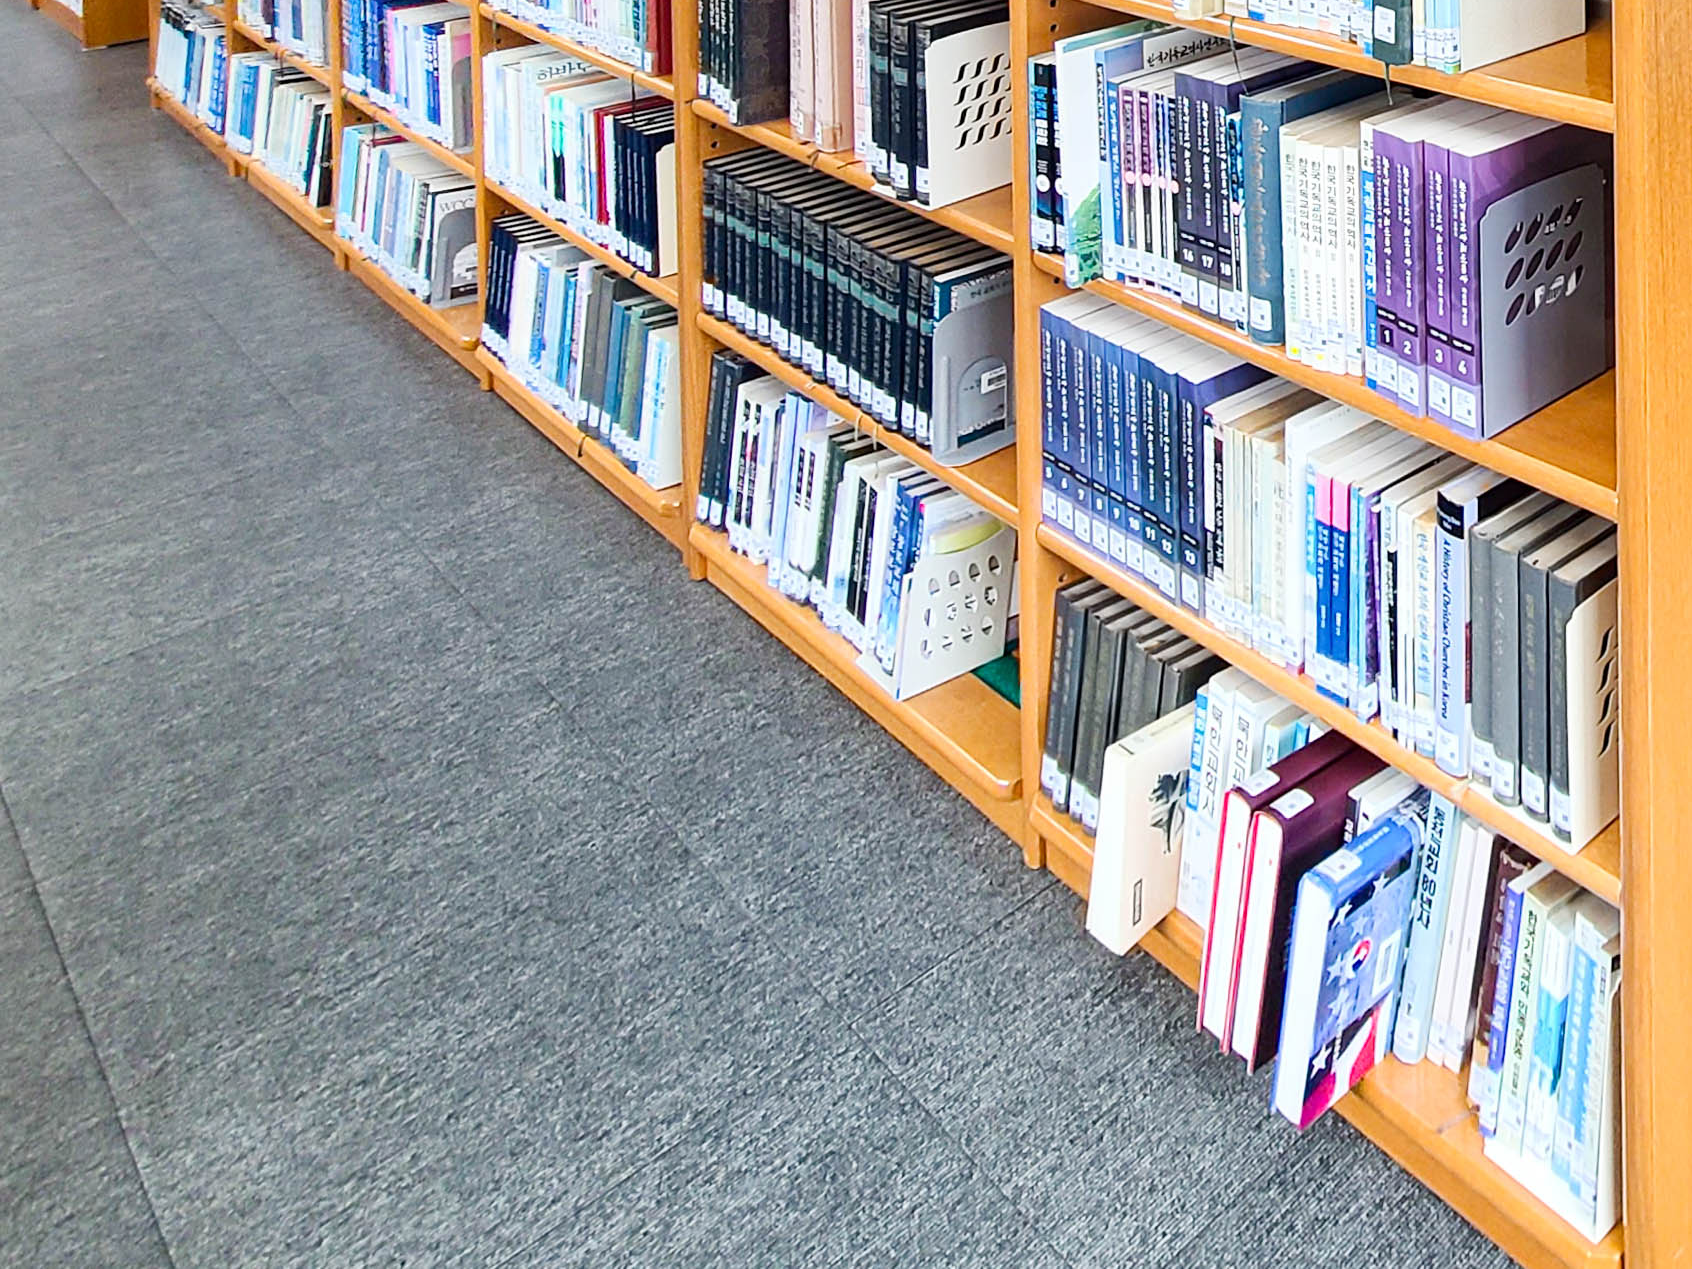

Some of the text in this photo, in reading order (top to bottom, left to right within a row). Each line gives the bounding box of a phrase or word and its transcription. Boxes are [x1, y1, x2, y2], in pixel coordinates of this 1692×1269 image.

[1183, 249, 1194, 262] 16
[1201, 255, 1213, 268] 17
[1220, 262, 1231, 275] 18
[1384, 330, 1390, 345] 1
[1403, 340, 1412, 355] 2
[1435, 348, 1443, 364] 3
[1458, 359, 1467, 375] 4
[1129, 516, 1140, 531] 10
[1145, 526, 1156, 541] 11
[1161, 538, 1173, 554] 12
[1184, 550, 1196, 566] 13
[1440, 548, 1452, 581] History
[1440, 594, 1453, 635] Christian
[1440, 637, 1453, 677] Churches
[1439, 693, 1451, 720] Korea
